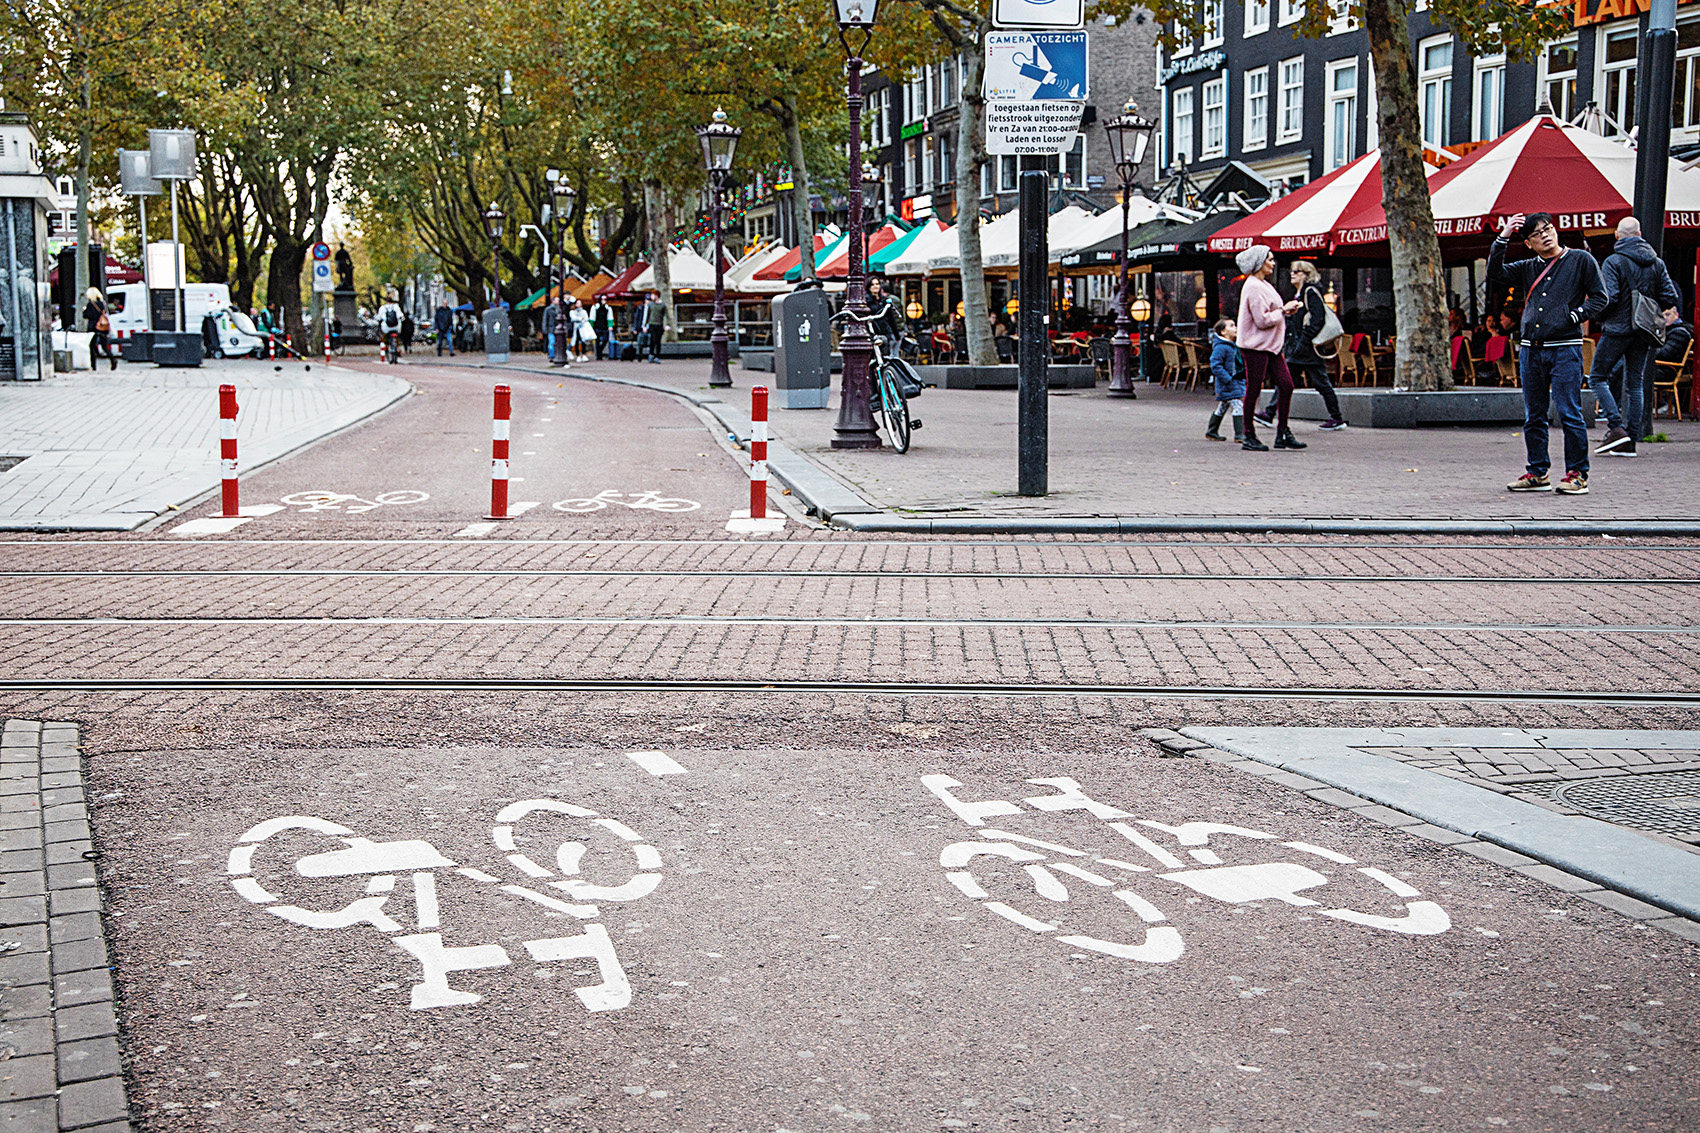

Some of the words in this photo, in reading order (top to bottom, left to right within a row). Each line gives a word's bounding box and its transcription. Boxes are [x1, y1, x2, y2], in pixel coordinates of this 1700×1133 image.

[994, 104, 1040, 113] toegestaan
[1041, 103, 1069, 112] fietsen
[1070, 105, 1080, 113] op
[988, 114, 1033, 122] fietsstrook
[1455, 216, 1482, 233] BIER
[1559, 212, 1607, 229] BIER
[1346, 225, 1387, 242] CENTRUM
[1210, 238, 1234, 250] AMSTEL
